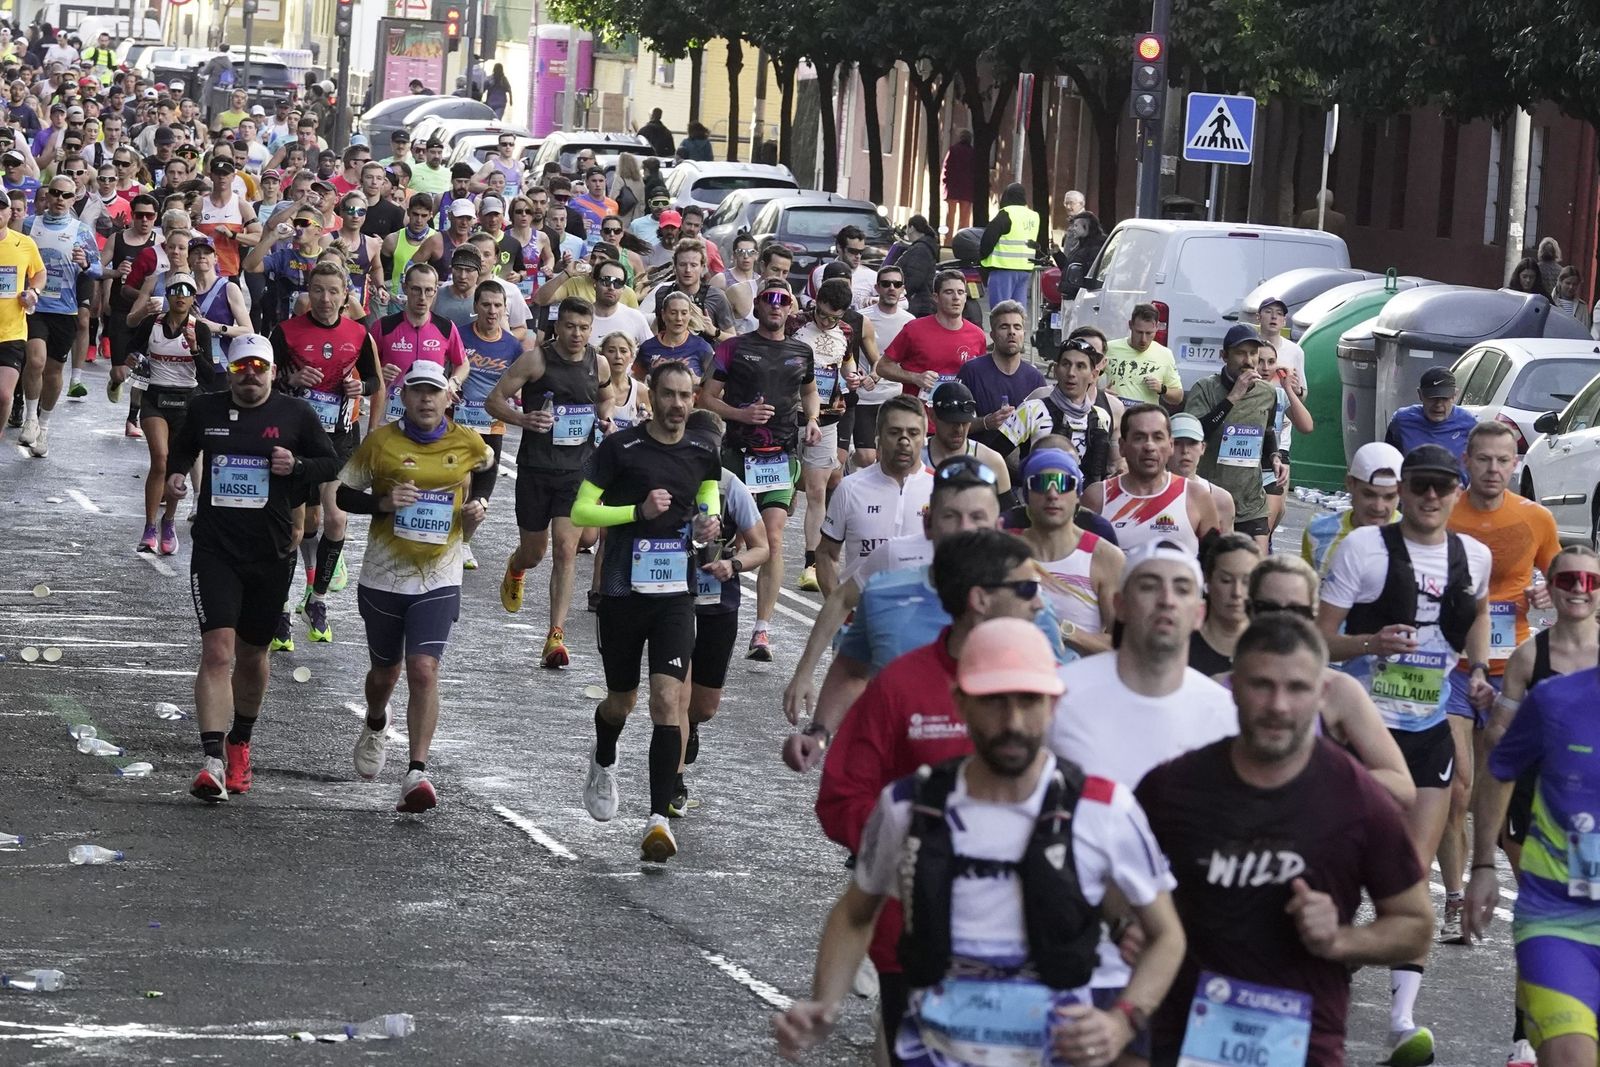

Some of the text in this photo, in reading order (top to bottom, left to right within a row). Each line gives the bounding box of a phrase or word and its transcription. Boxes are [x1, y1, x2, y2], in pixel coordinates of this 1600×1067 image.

[1188, 346, 1216, 360] 9177
[568, 406, 592, 414] ZURICH
[568, 427, 583, 436] FER
[1237, 427, 1260, 436] ZURICH
[1228, 447, 1253, 458] MANU
[231, 457, 263, 466] ZURICH
[231, 473, 248, 481] 7058
[755, 474, 781, 484] BITOR
[219, 483, 260, 495] HASSEL
[418, 492, 449, 503] ZURICH
[416, 506, 434, 516] 6874
[395, 515, 451, 532] EL CUERPO
[654, 541, 682, 550] ZURICH
[653, 558, 671, 566] 9340
[649, 568, 673, 580] TONI
[1489, 604, 1510, 613] RICH
[1403, 653, 1442, 666] ZURICH
[1372, 679, 1441, 703] GUILLAUME
[1206, 848, 1306, 888] WILD
[1236, 988, 1303, 1016] ZURICH
